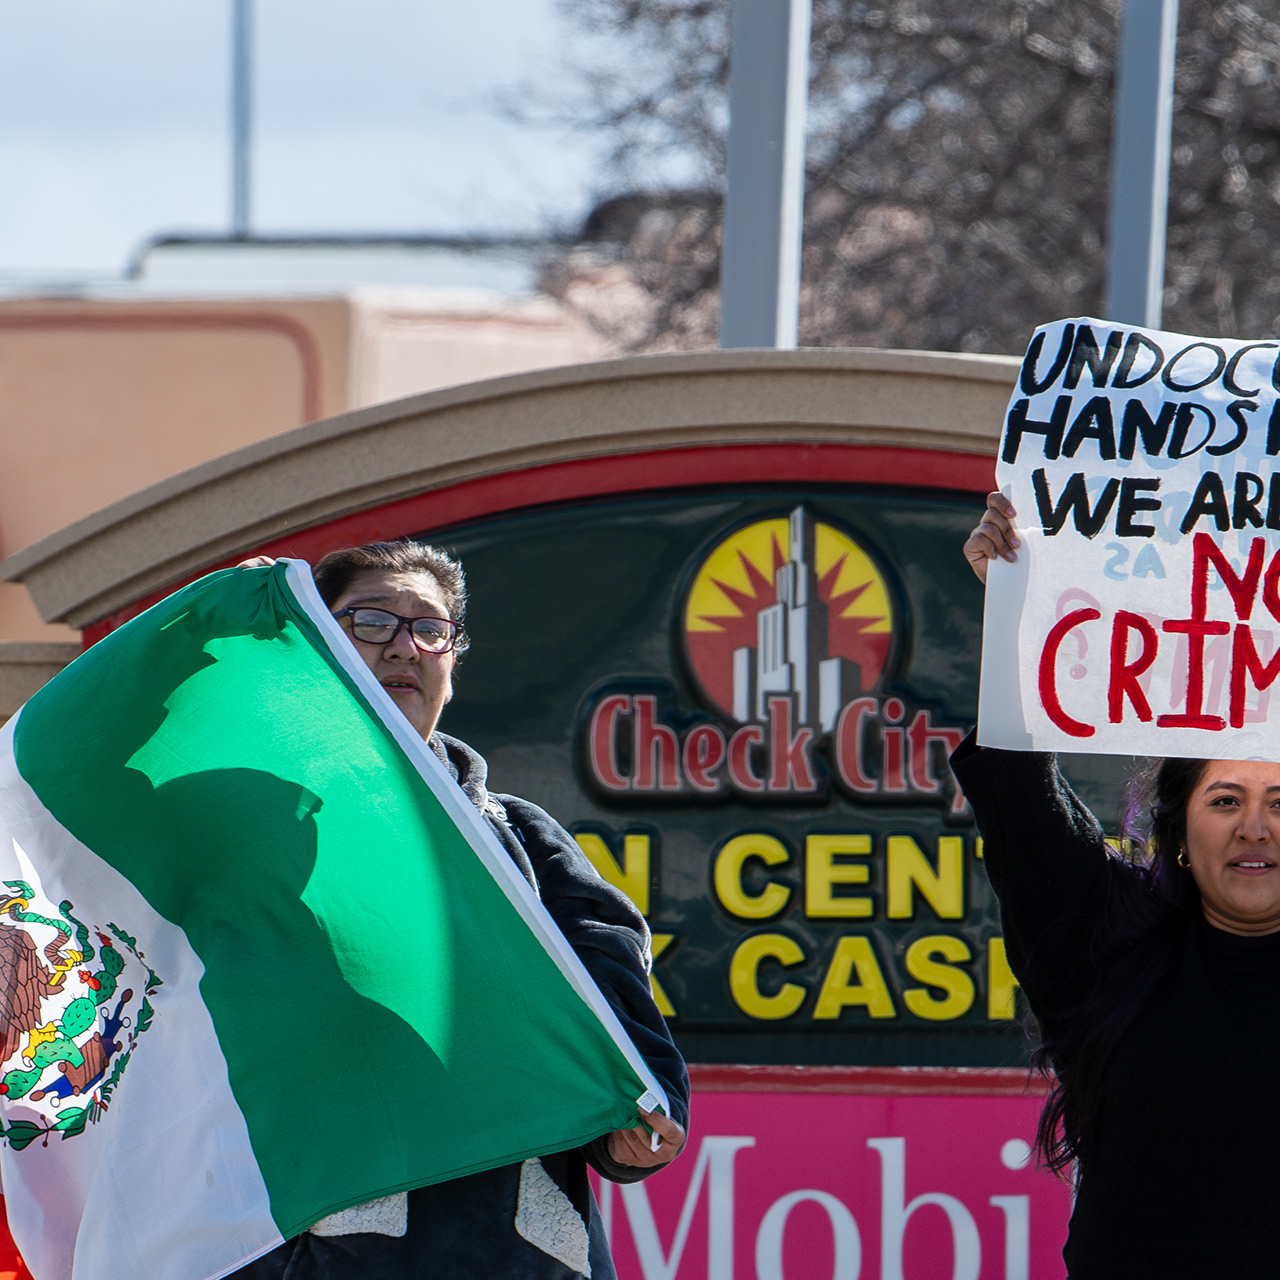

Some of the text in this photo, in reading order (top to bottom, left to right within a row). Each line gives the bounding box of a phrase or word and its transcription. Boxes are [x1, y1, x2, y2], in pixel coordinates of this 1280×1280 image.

[1002, 396, 1259, 464] HANDS
[1031, 468, 1162, 538] WE
[589, 694, 817, 792] Check
[714, 833, 984, 920] CEN
